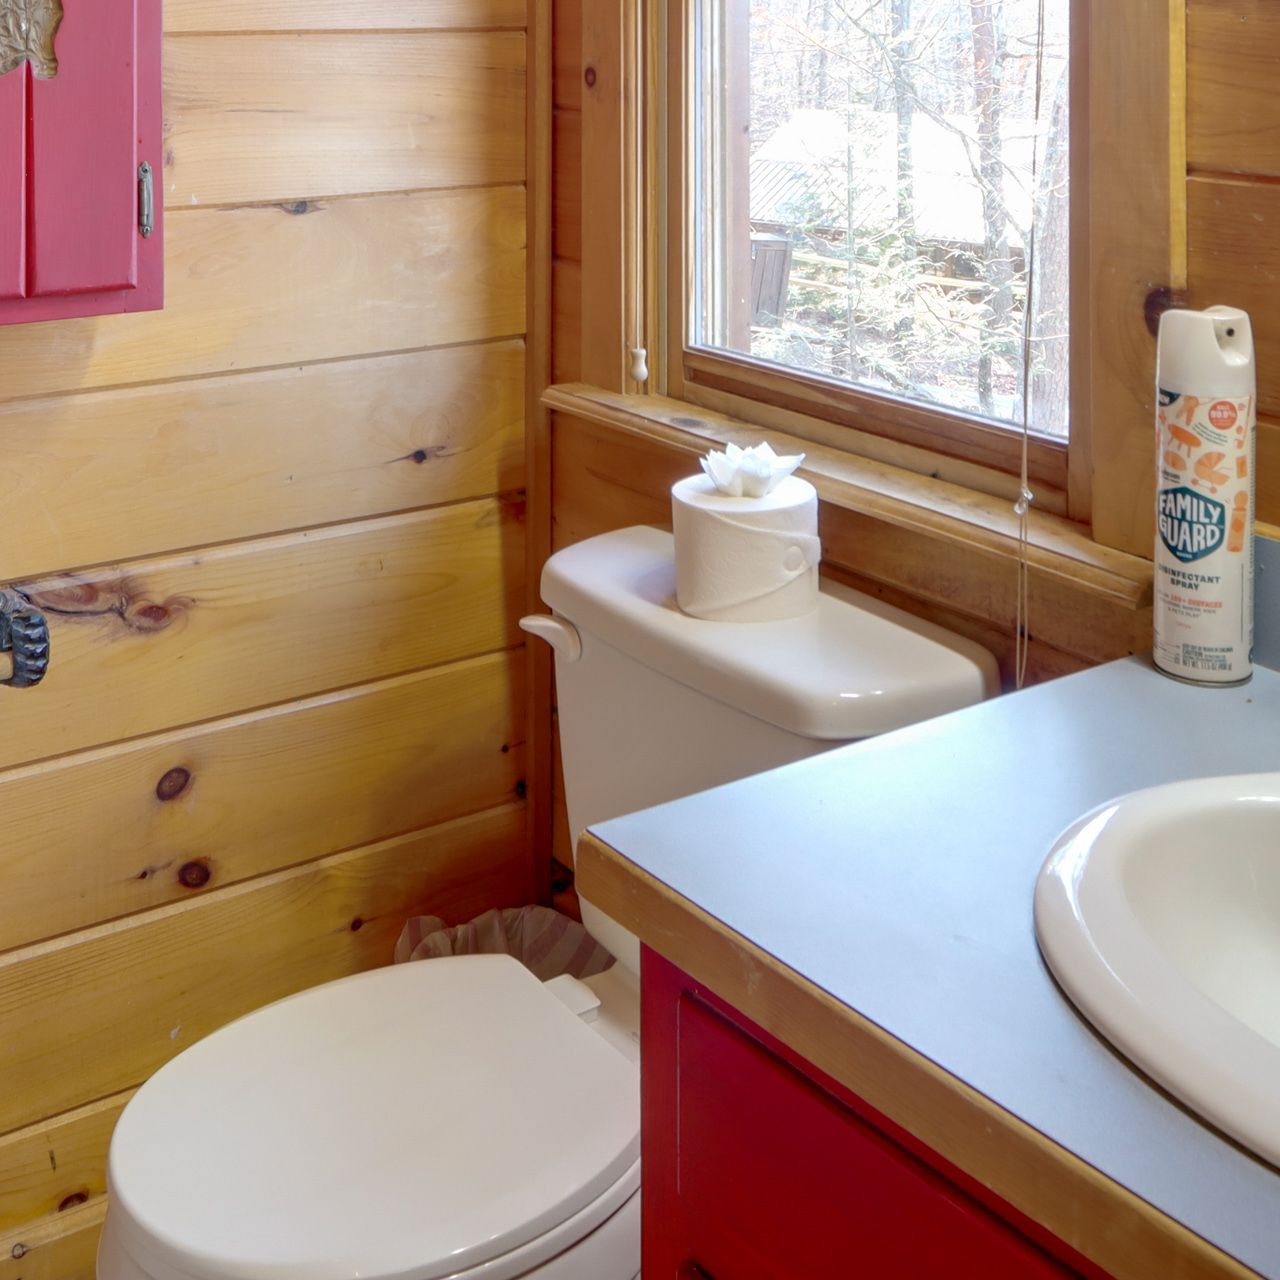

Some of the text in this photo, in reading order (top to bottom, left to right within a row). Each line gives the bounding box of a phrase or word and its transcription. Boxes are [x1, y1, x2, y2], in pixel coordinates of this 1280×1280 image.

[1160, 493, 1222, 524] FAMILY
[1159, 514, 1221, 553] GUARD
[1170, 578, 1200, 591] SPRAY
